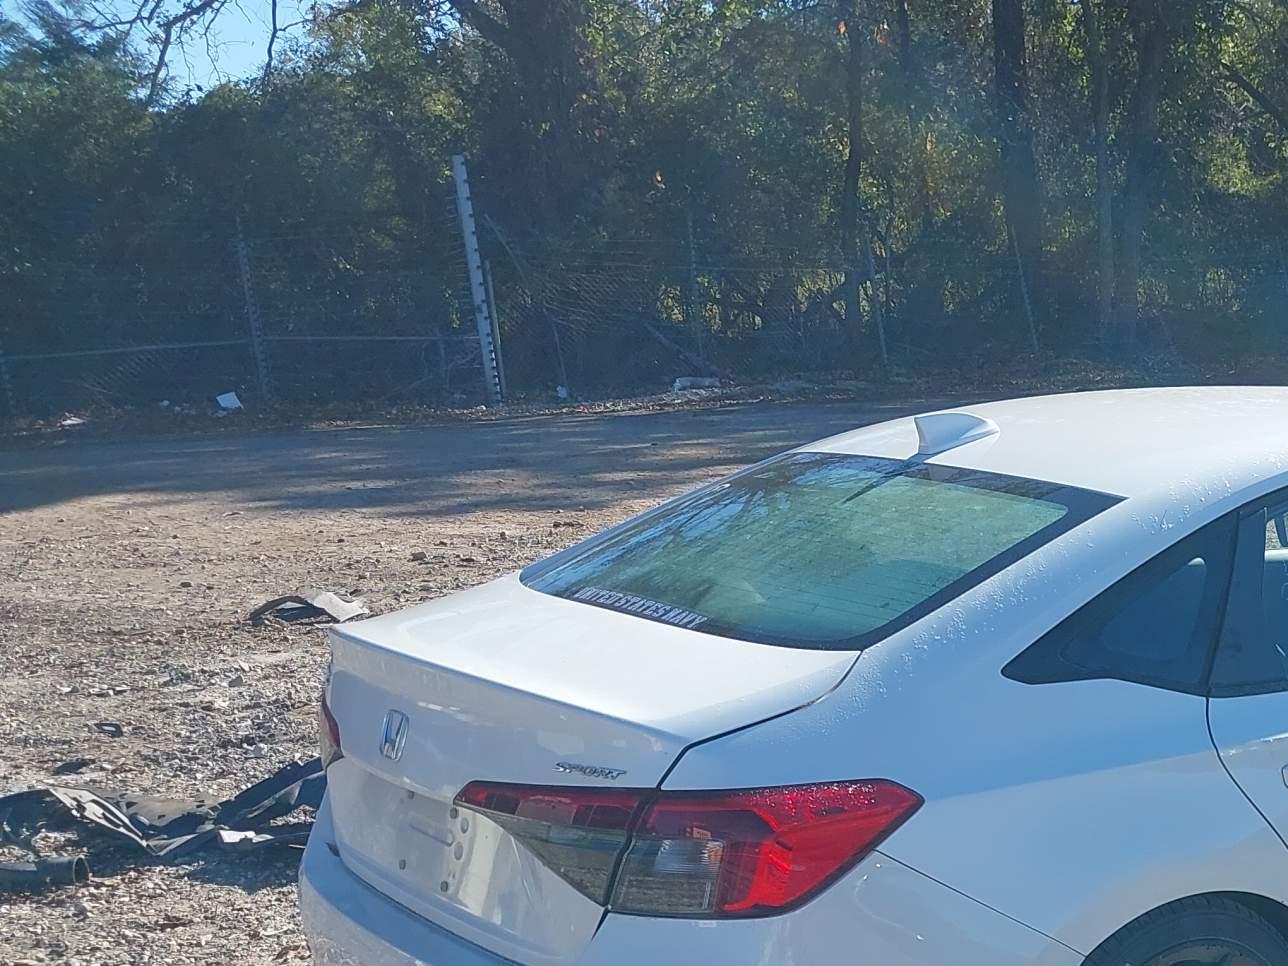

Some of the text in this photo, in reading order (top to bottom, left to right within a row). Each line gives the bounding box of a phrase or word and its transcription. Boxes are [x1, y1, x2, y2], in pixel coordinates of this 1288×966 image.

[573, 586, 707, 628] UNITED STATES NAVY
[552, 761, 627, 780] SPORT
